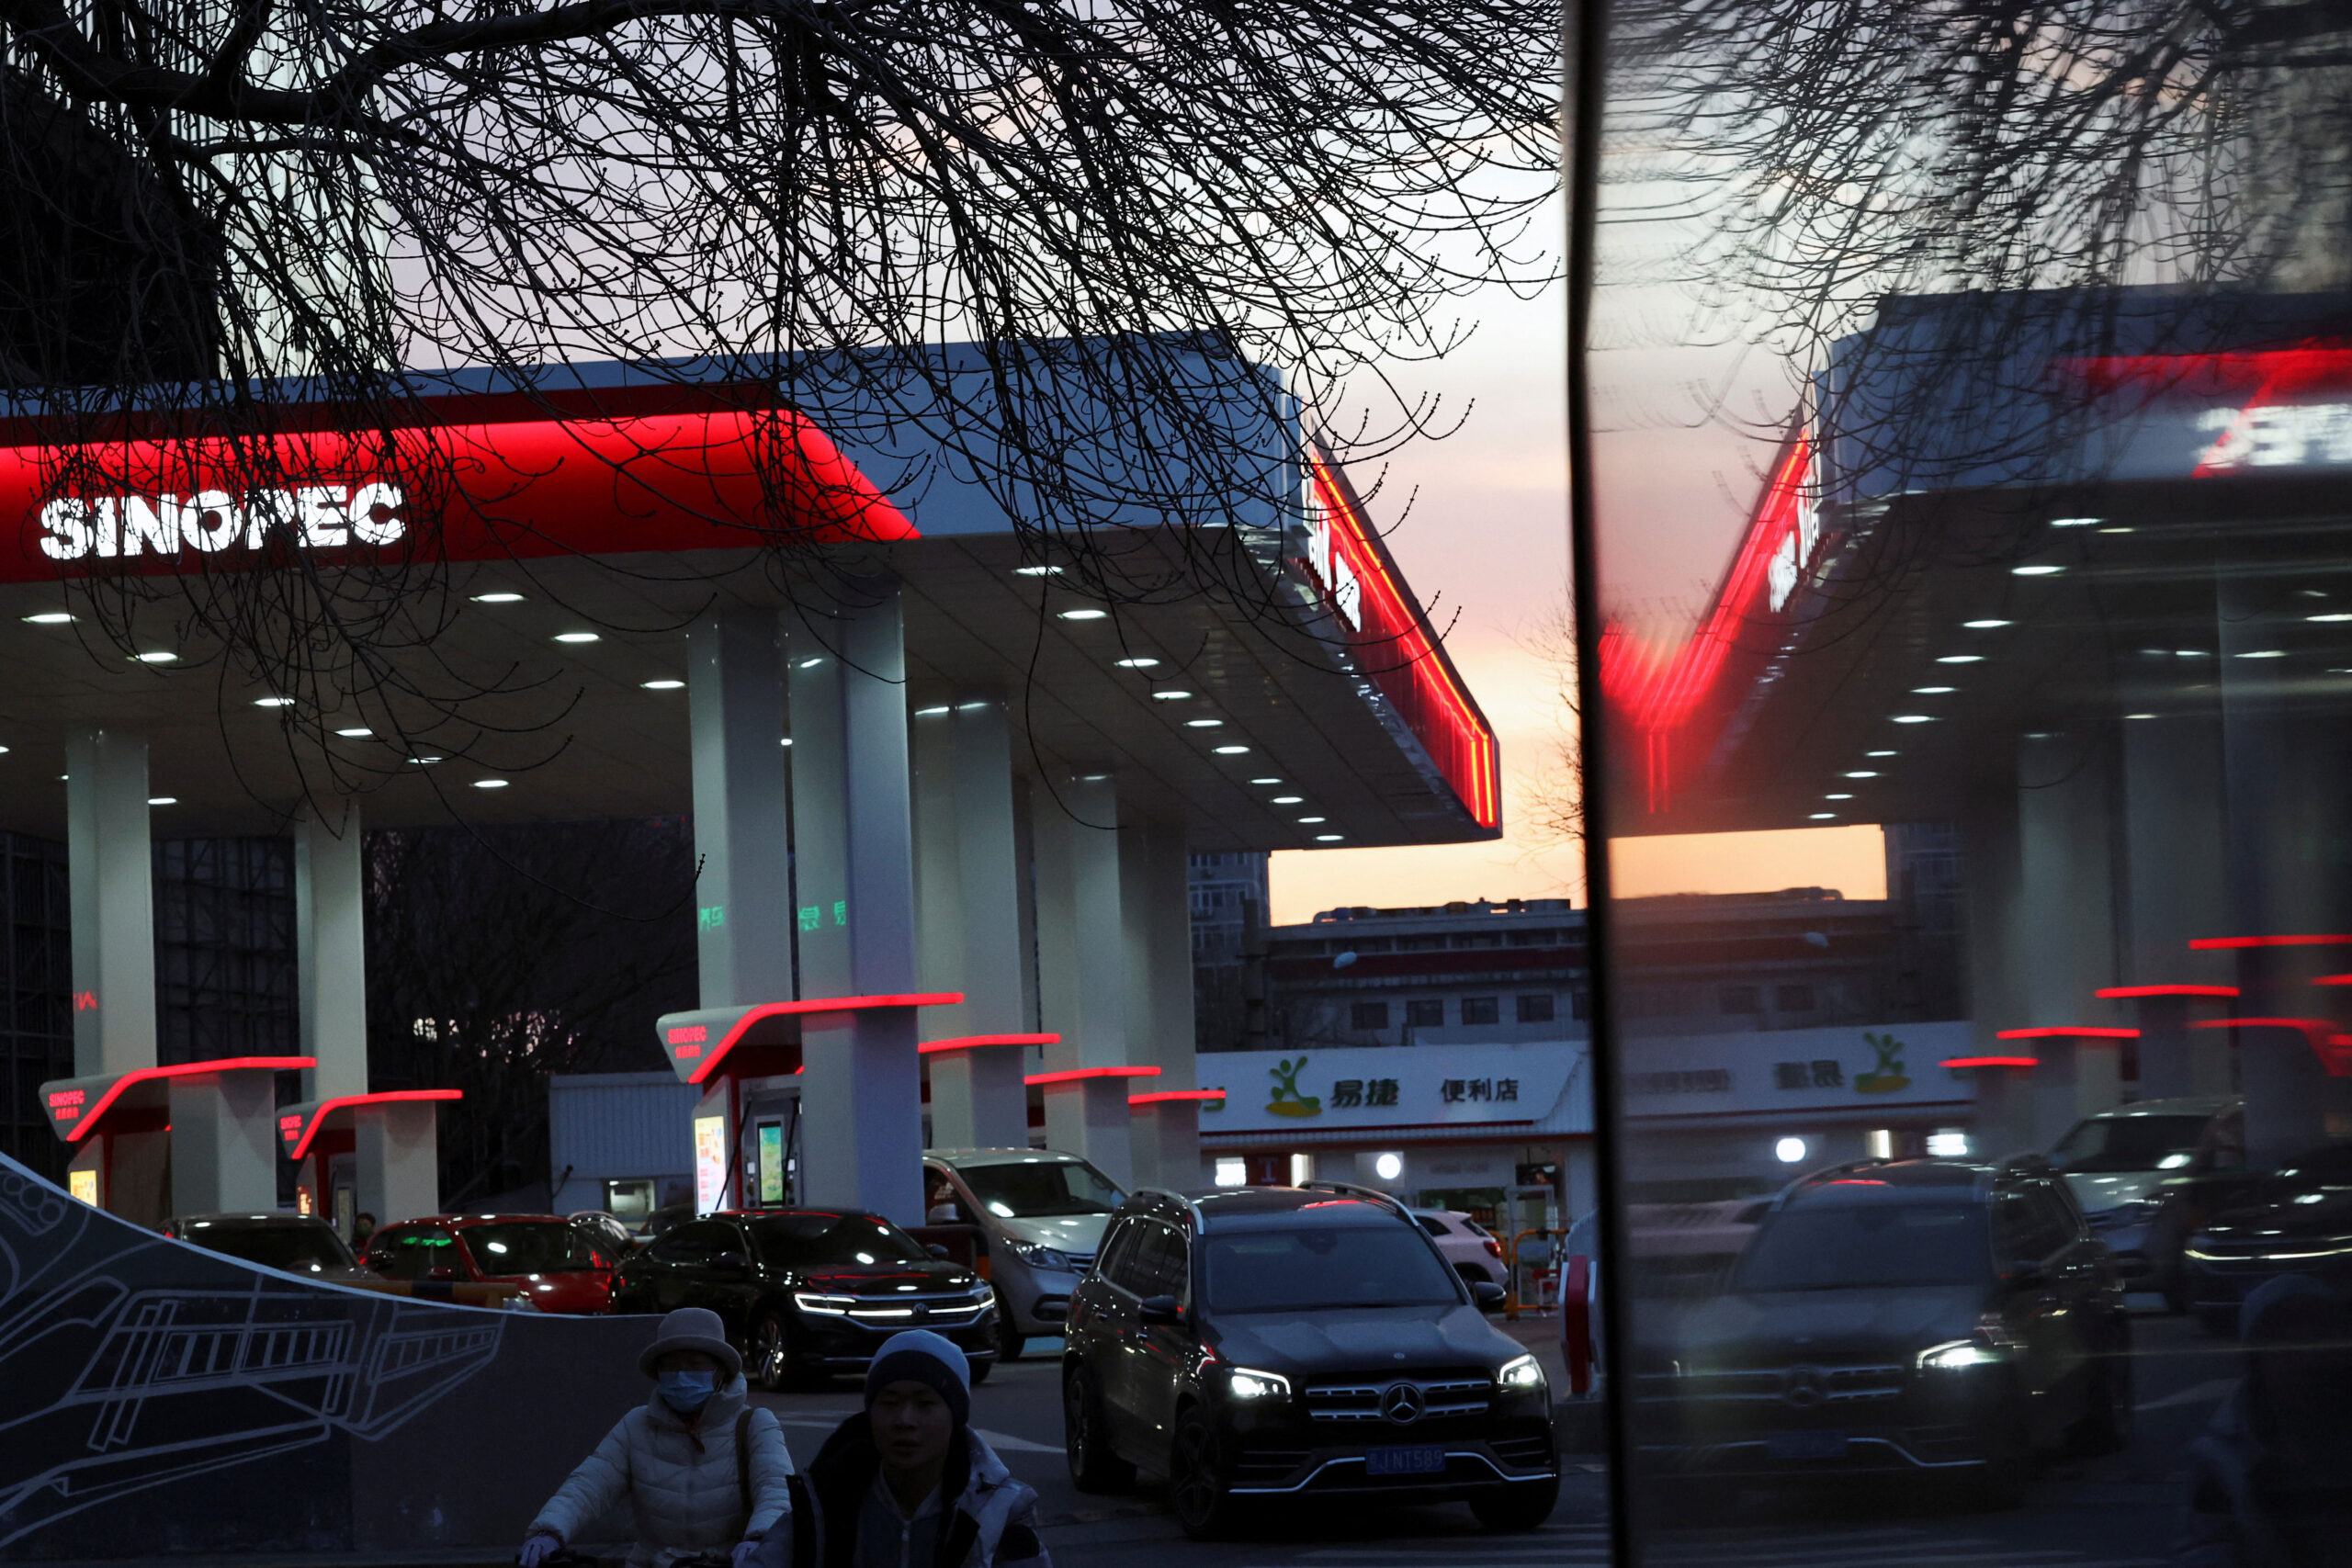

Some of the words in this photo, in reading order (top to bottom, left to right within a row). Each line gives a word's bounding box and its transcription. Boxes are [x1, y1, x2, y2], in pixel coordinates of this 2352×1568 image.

[39, 482, 406, 559] SINOPEC
[49, 1089, 85, 1108] SINOPEC
[1331, 1078, 1399, 1108] 易捷
[1441, 1077, 1519, 1103] 便利店
